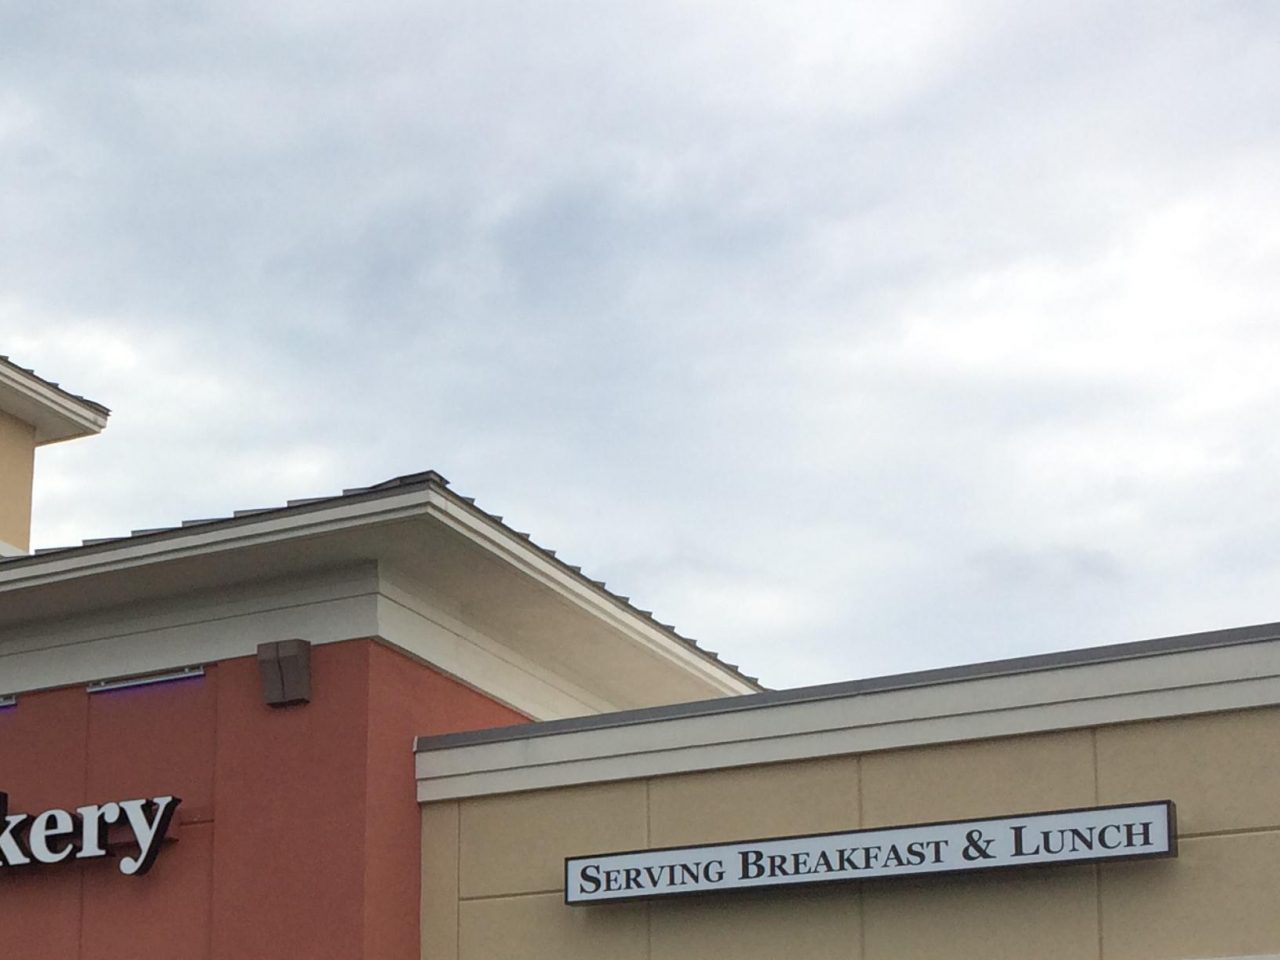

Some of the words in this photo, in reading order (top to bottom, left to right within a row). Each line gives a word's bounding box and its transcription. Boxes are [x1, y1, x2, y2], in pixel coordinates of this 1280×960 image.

[579, 859, 725, 894] SERVING
[738, 840, 949, 880] BREAKFAST
[961, 829, 996, 860] &
[1009, 821, 1153, 856] LUNCH
